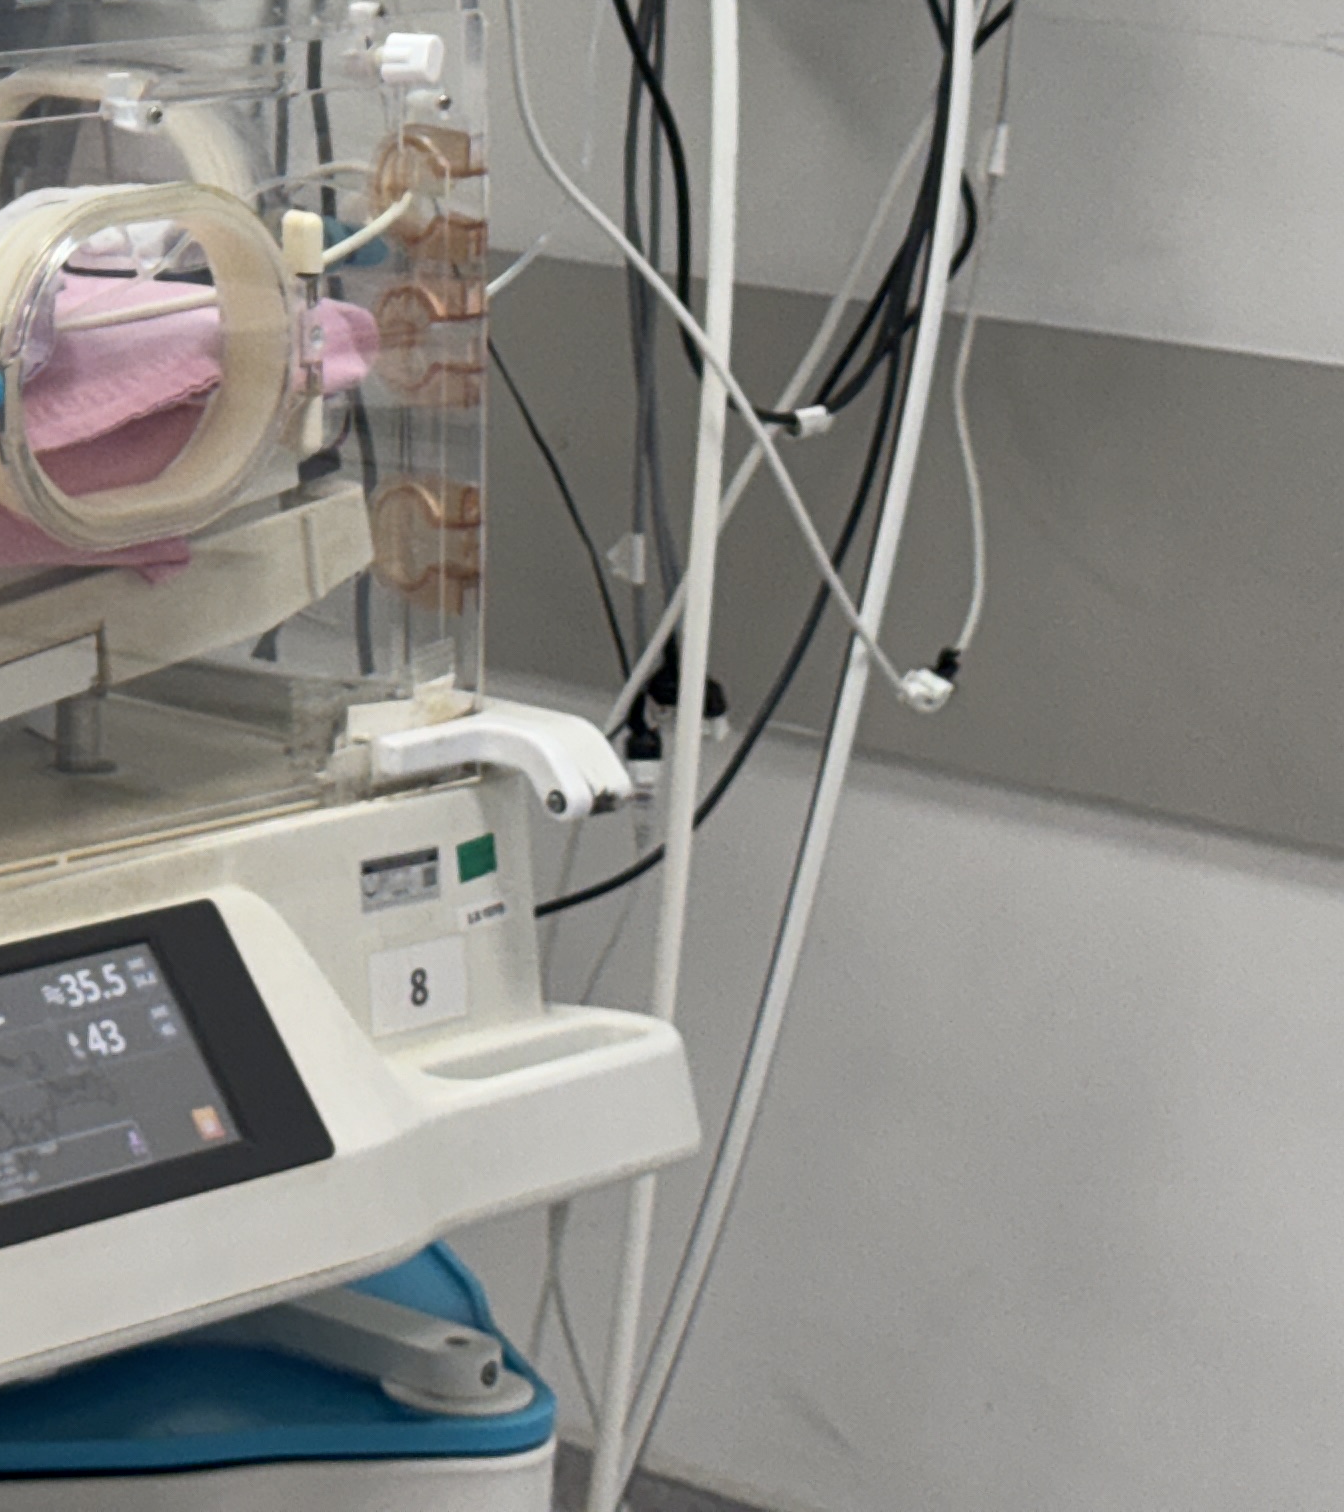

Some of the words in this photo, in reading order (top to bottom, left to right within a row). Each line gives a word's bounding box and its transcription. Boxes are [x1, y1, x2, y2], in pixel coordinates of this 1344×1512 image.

[58, 962, 128, 1008] 35.5
[410, 966, 429, 1008] 8
[87, 1018, 127, 1055] 43
